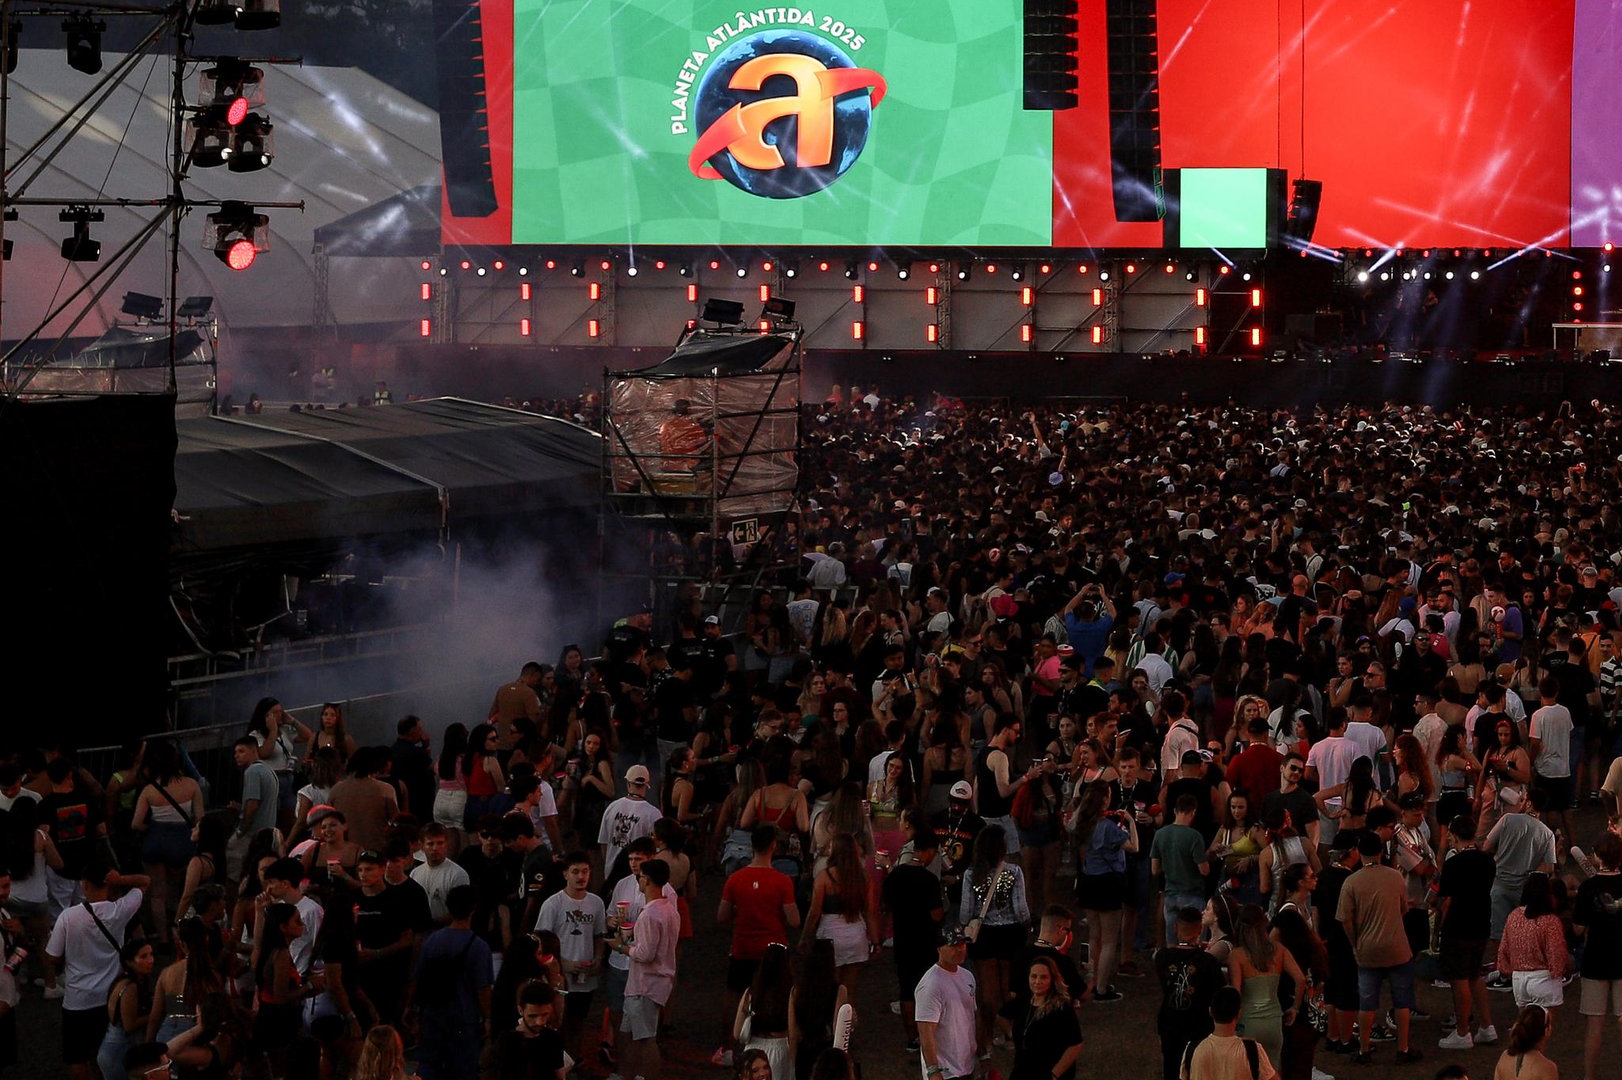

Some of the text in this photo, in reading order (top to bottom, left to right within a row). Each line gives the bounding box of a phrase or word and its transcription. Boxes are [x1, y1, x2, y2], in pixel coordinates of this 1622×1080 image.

[671, 7, 866, 135] PLANETA ATLÂNTIDA 2025
[727, 53, 834, 171] a
